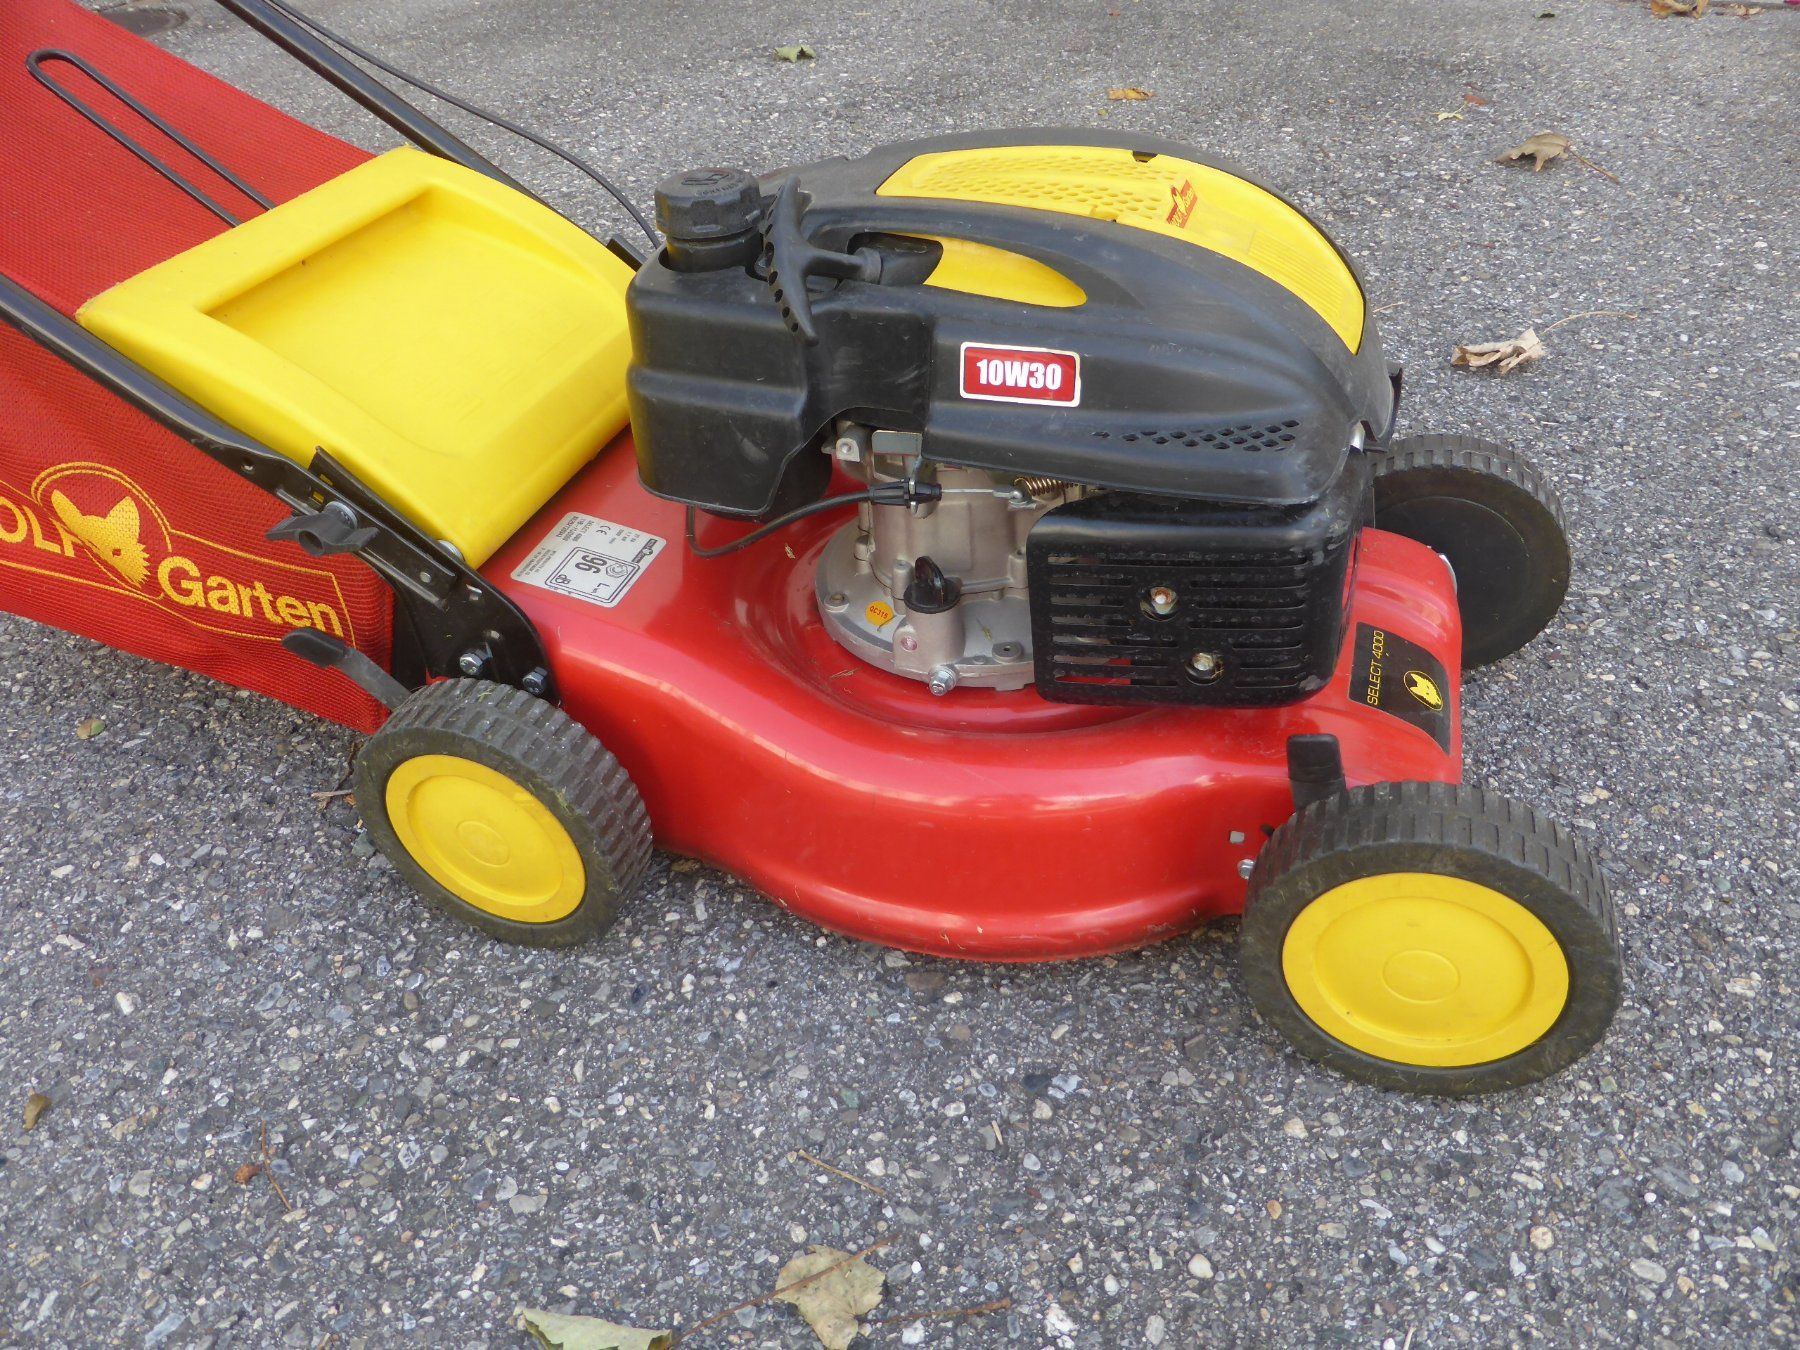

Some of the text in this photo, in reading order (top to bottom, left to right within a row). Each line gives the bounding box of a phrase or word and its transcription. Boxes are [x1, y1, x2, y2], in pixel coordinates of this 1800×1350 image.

[976, 359, 1062, 390] 10W30
[575, 554, 607, 573] 96
[157, 555, 344, 638] Garten
[1367, 630, 1384, 705] SELECT 4000
